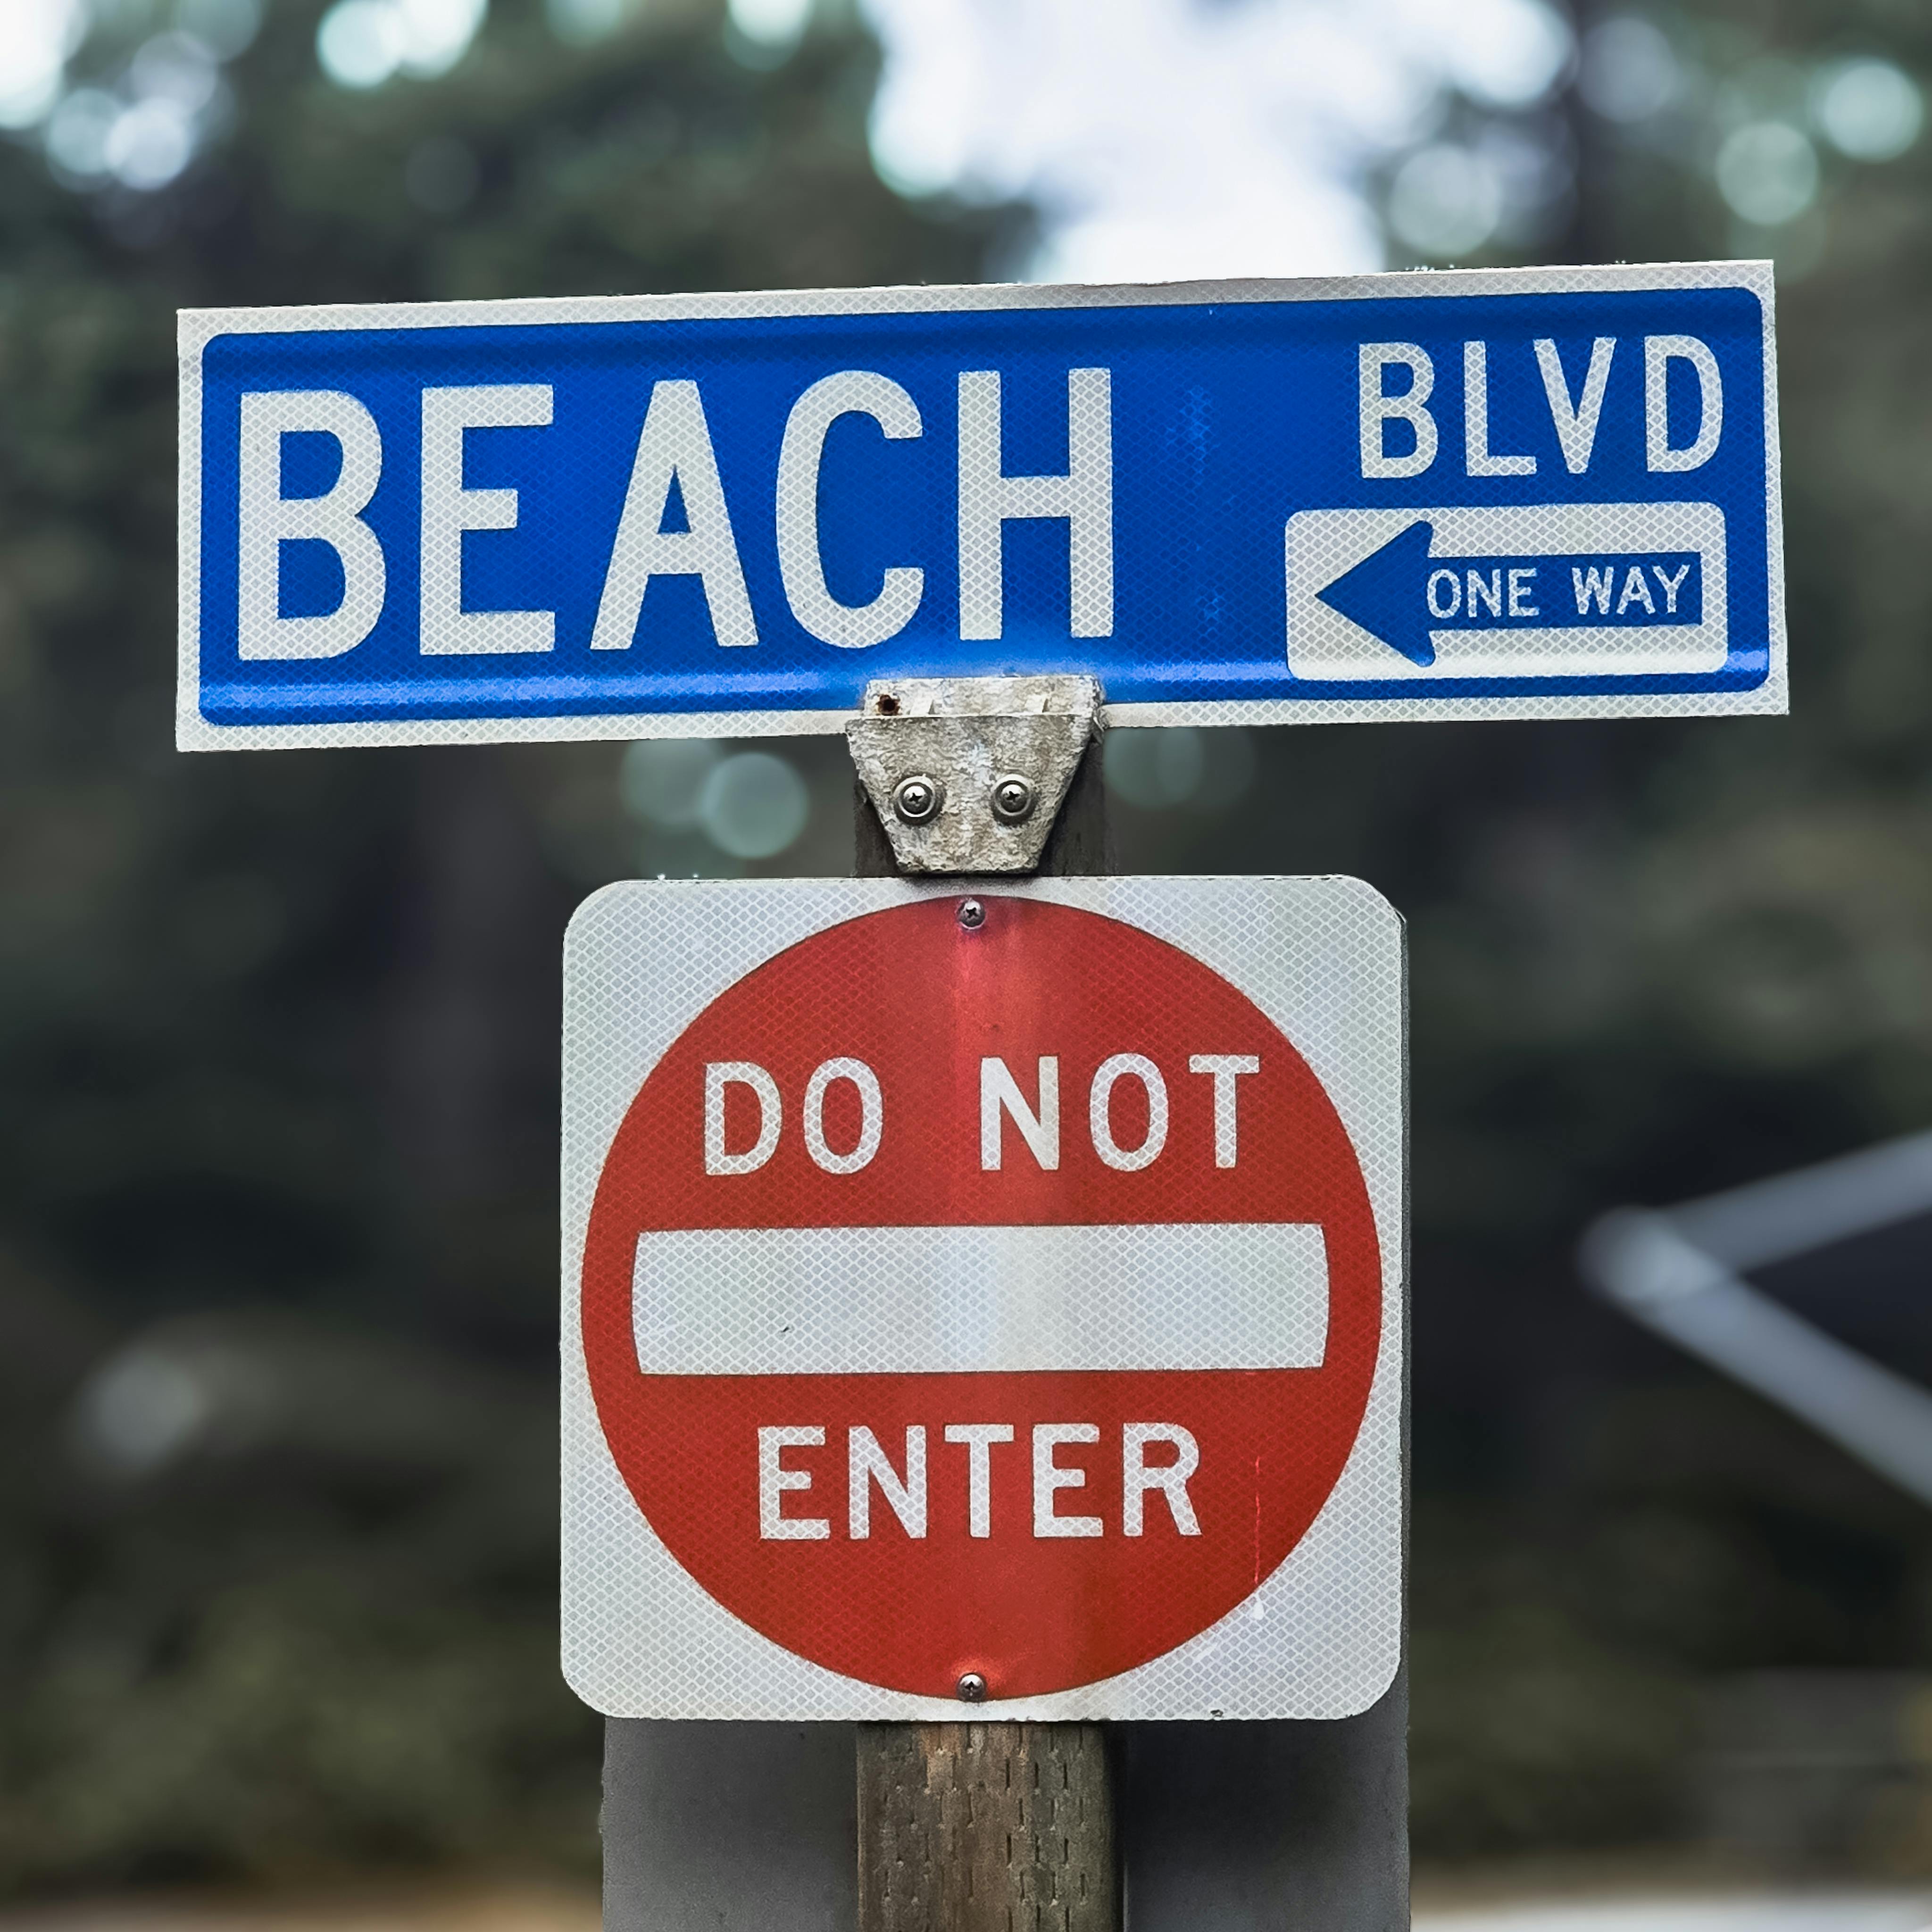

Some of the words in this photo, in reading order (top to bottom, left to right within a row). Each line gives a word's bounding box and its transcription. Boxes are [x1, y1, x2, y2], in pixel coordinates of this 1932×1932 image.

[238, 368, 1114, 661] BEACH
[1358, 334, 1724, 479] BLVD
[1426, 567, 1539, 618] ONE
[1572, 564, 1690, 616] WAY
[704, 1057, 883, 1175] DO
[980, 1053, 1259, 1172] NOT
[758, 1423, 1201, 1540] ENTER
